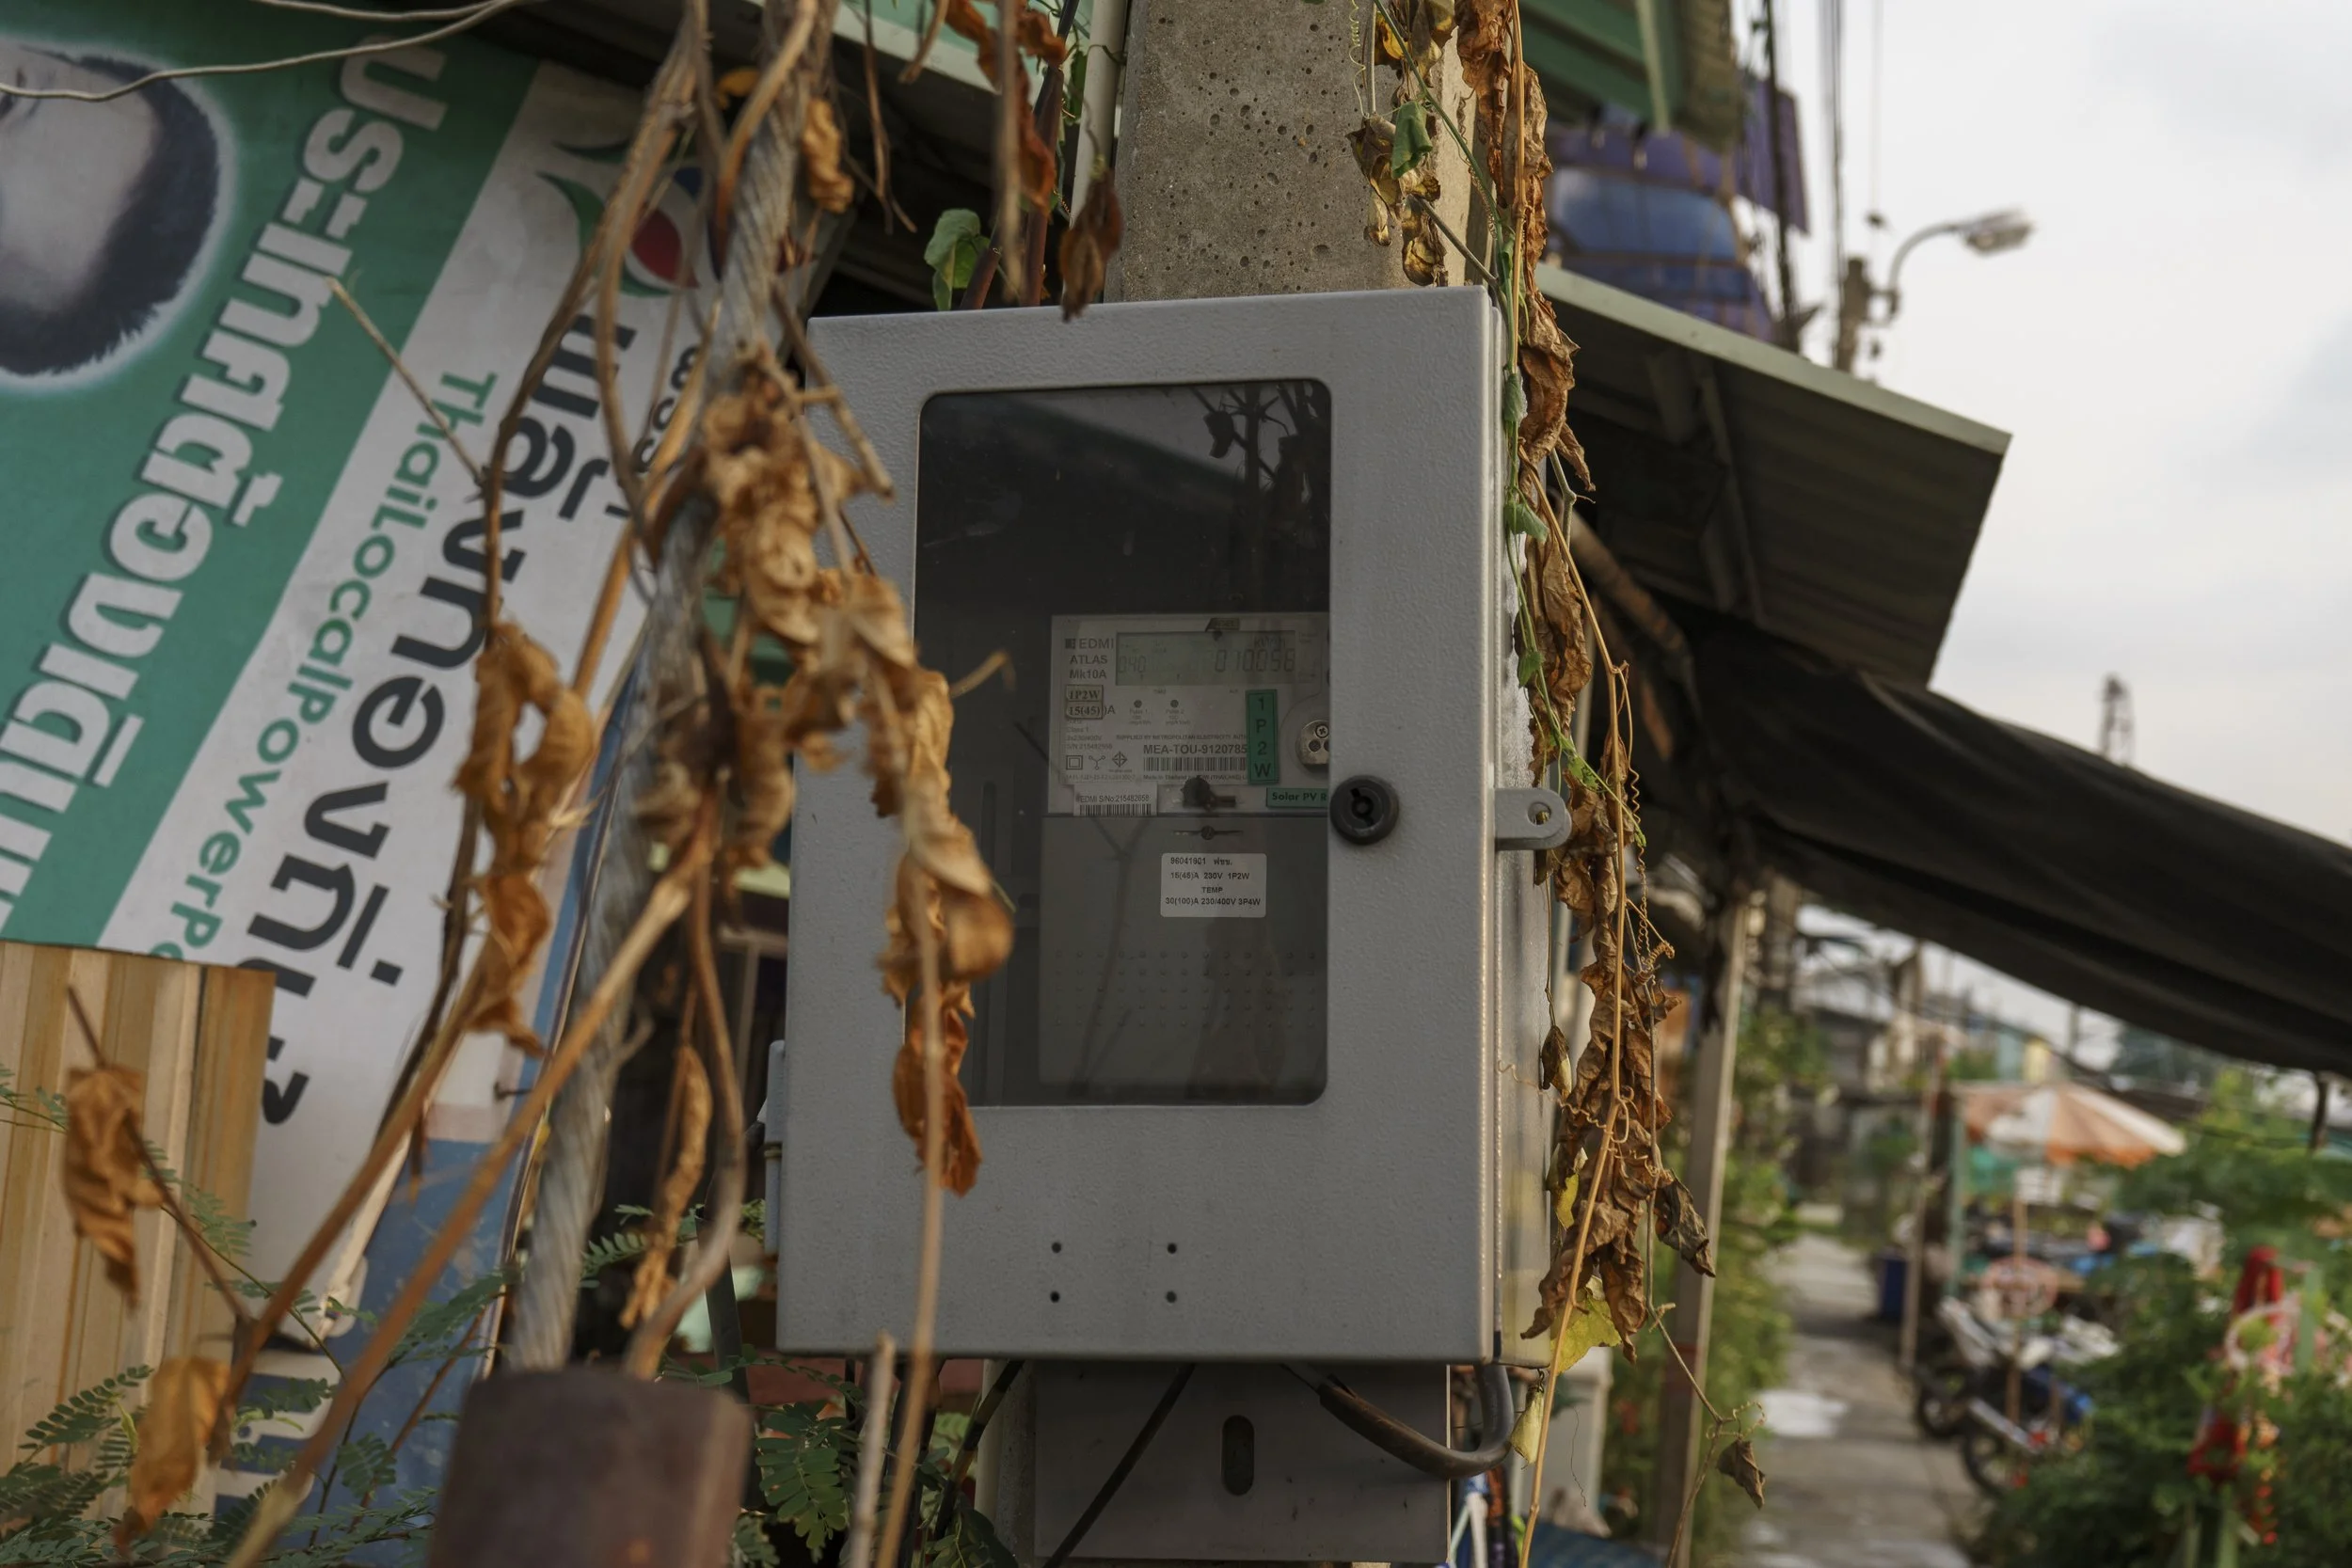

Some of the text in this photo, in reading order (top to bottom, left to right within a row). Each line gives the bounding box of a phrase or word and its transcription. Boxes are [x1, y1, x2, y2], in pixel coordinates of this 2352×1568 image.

[0, 35, 449, 934] ประเทศต้องเดิน
[1079, 638, 1114, 649] EDMI
[1069, 655, 1108, 665] ATLAS
[1069, 669, 1107, 679] Mk10A
[1069, 689, 1101, 700] 1P2W
[1272, 791, 1300, 801] Solar
[1303, 791, 1318, 801] PV
[1200, 897, 1236, 906] 230/400V
[1238, 897, 1261, 906] 3P4W
